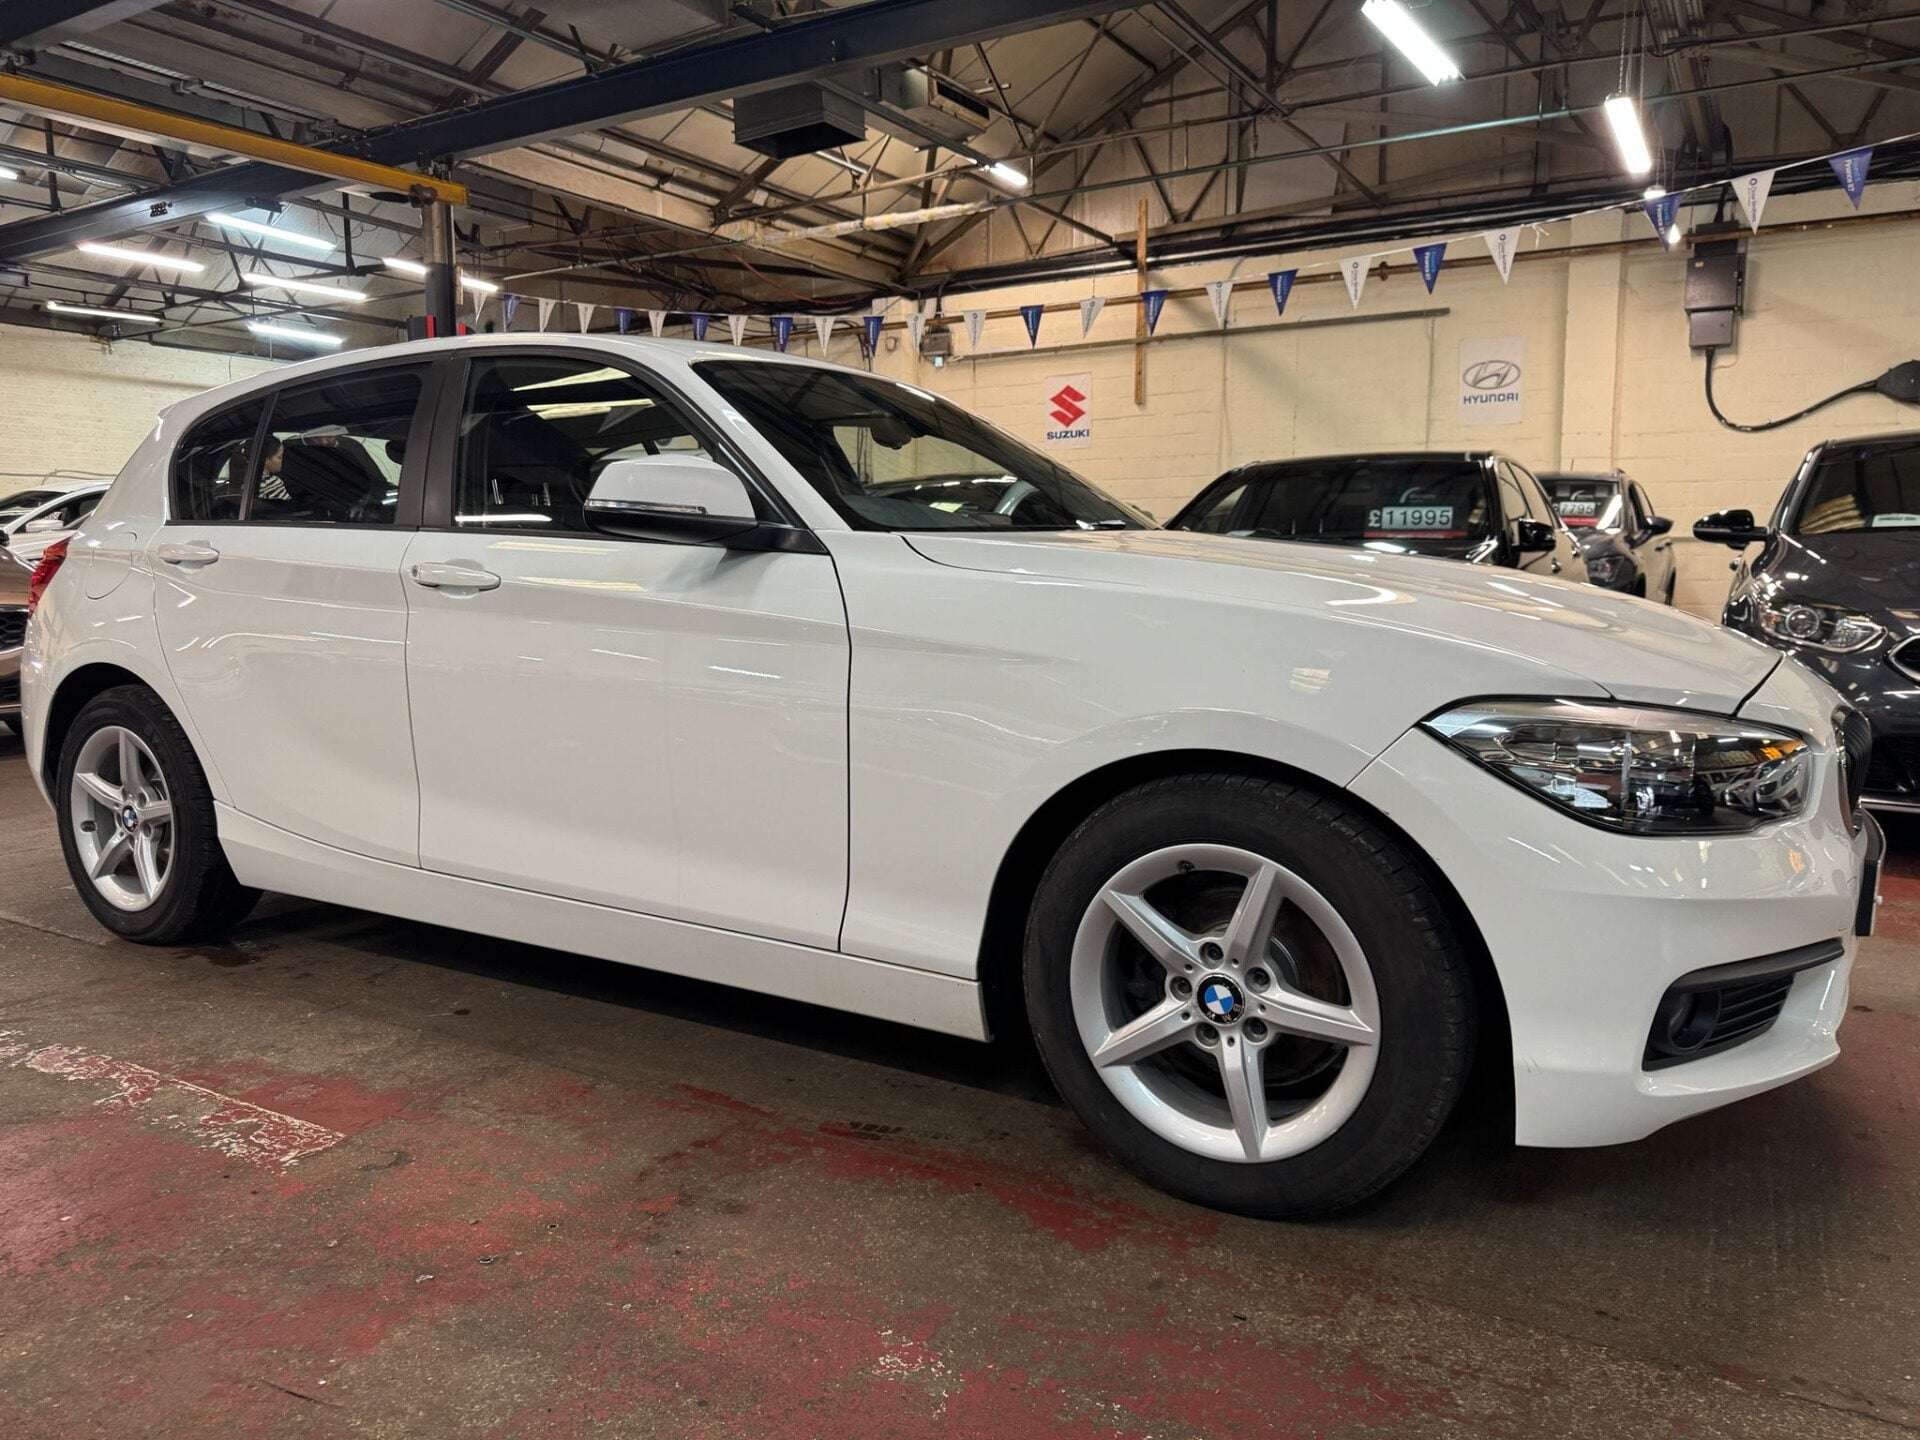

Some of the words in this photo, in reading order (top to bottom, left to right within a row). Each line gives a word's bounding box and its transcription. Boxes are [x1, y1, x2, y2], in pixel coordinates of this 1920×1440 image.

[1463, 392, 1519, 405] HYUNDAI
[1046, 429, 1090, 440] SUZUKI
[1367, 508, 1451, 527] £11995
